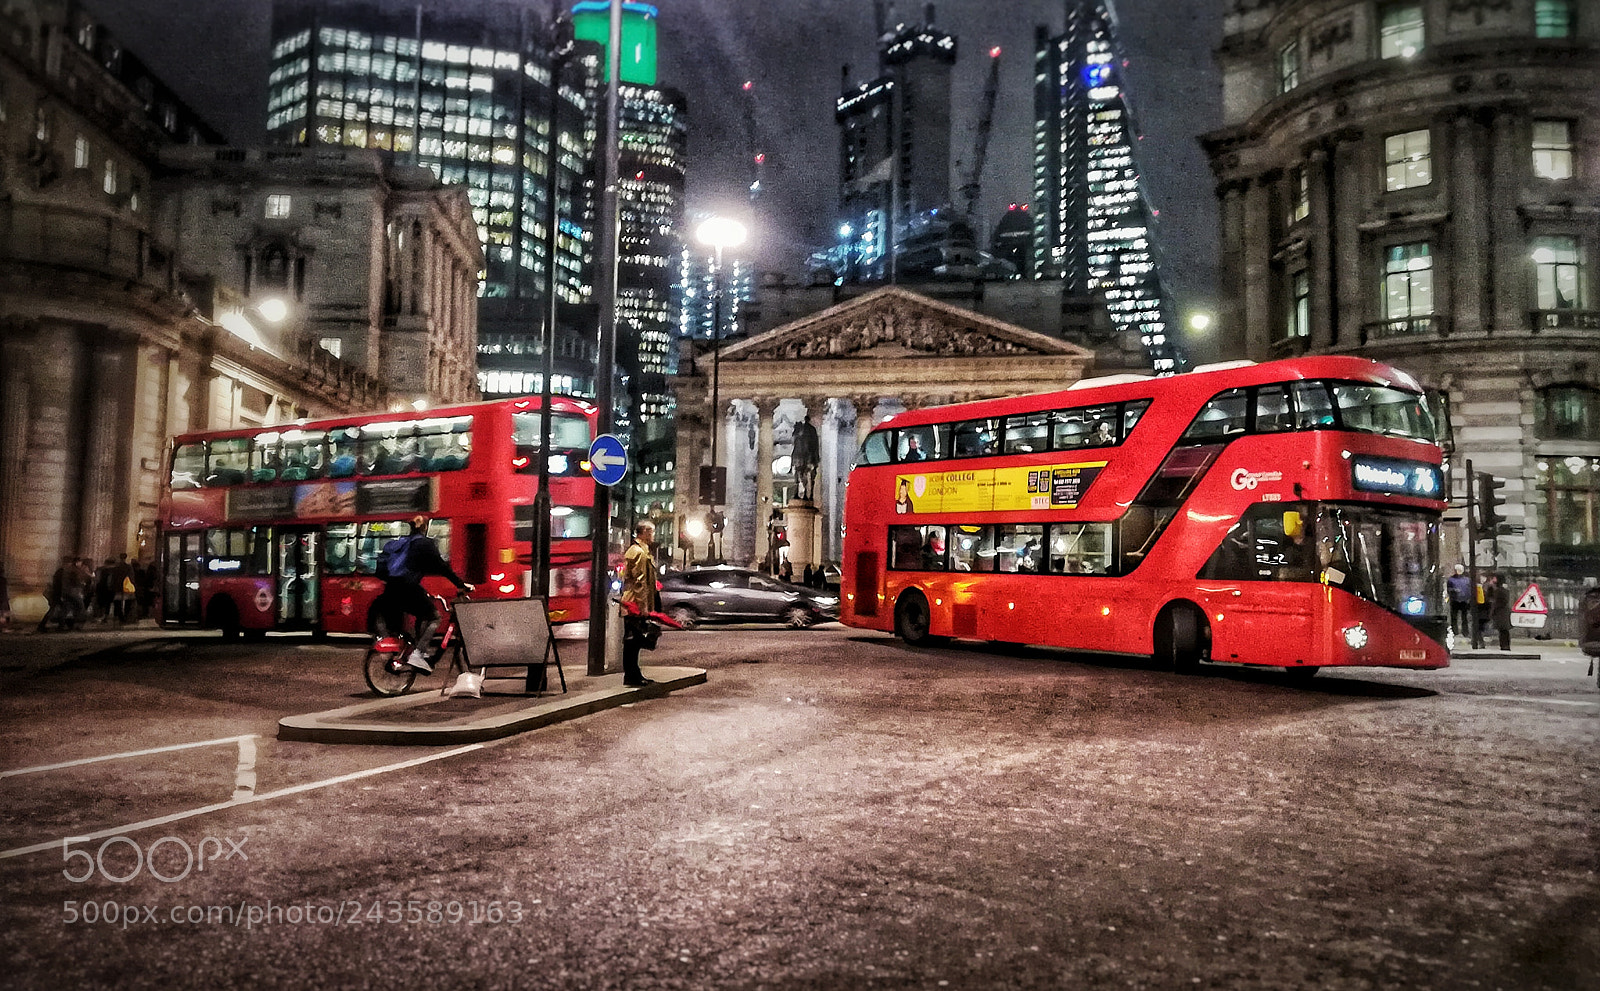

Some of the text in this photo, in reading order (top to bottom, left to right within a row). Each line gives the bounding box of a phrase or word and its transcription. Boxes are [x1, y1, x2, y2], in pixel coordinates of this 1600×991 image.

[946, 472, 975, 482] COLLEGE
[1231, 468, 1258, 490] Go
[1415, 467, 1439, 492] 76
[928, 487, 958, 496] LONDON
[1518, 616, 1536, 625] End
